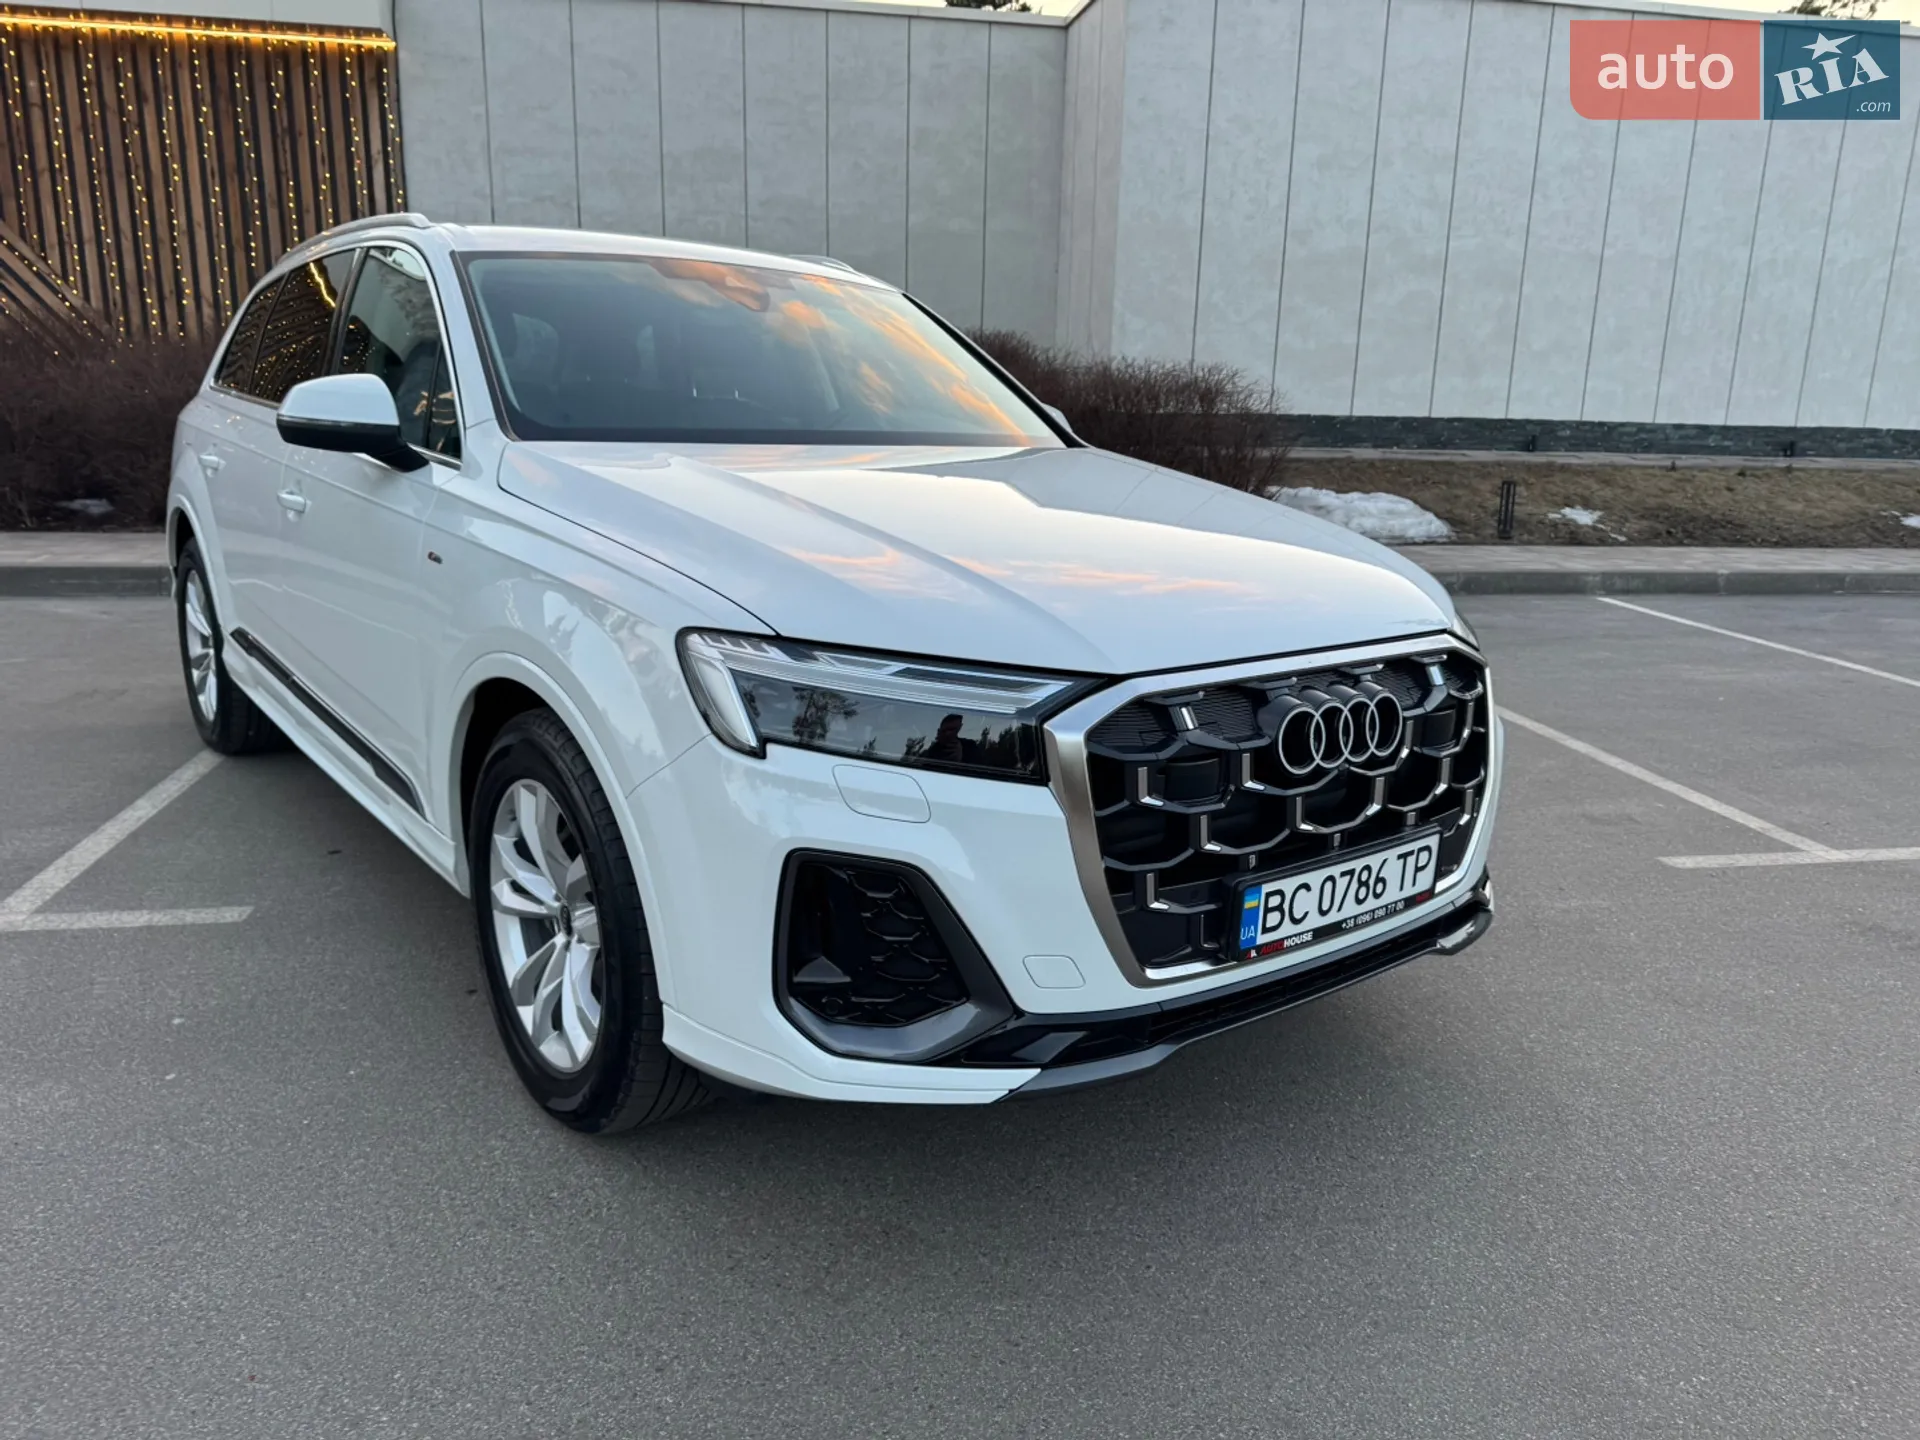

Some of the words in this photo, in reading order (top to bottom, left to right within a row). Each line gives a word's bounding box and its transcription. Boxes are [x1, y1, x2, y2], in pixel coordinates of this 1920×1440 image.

[1261, 882, 1311, 935] BC
[1318, 857, 1388, 917] 0786
[1397, 844, 1432, 892] TP
[1240, 925, 1255, 940] UA
